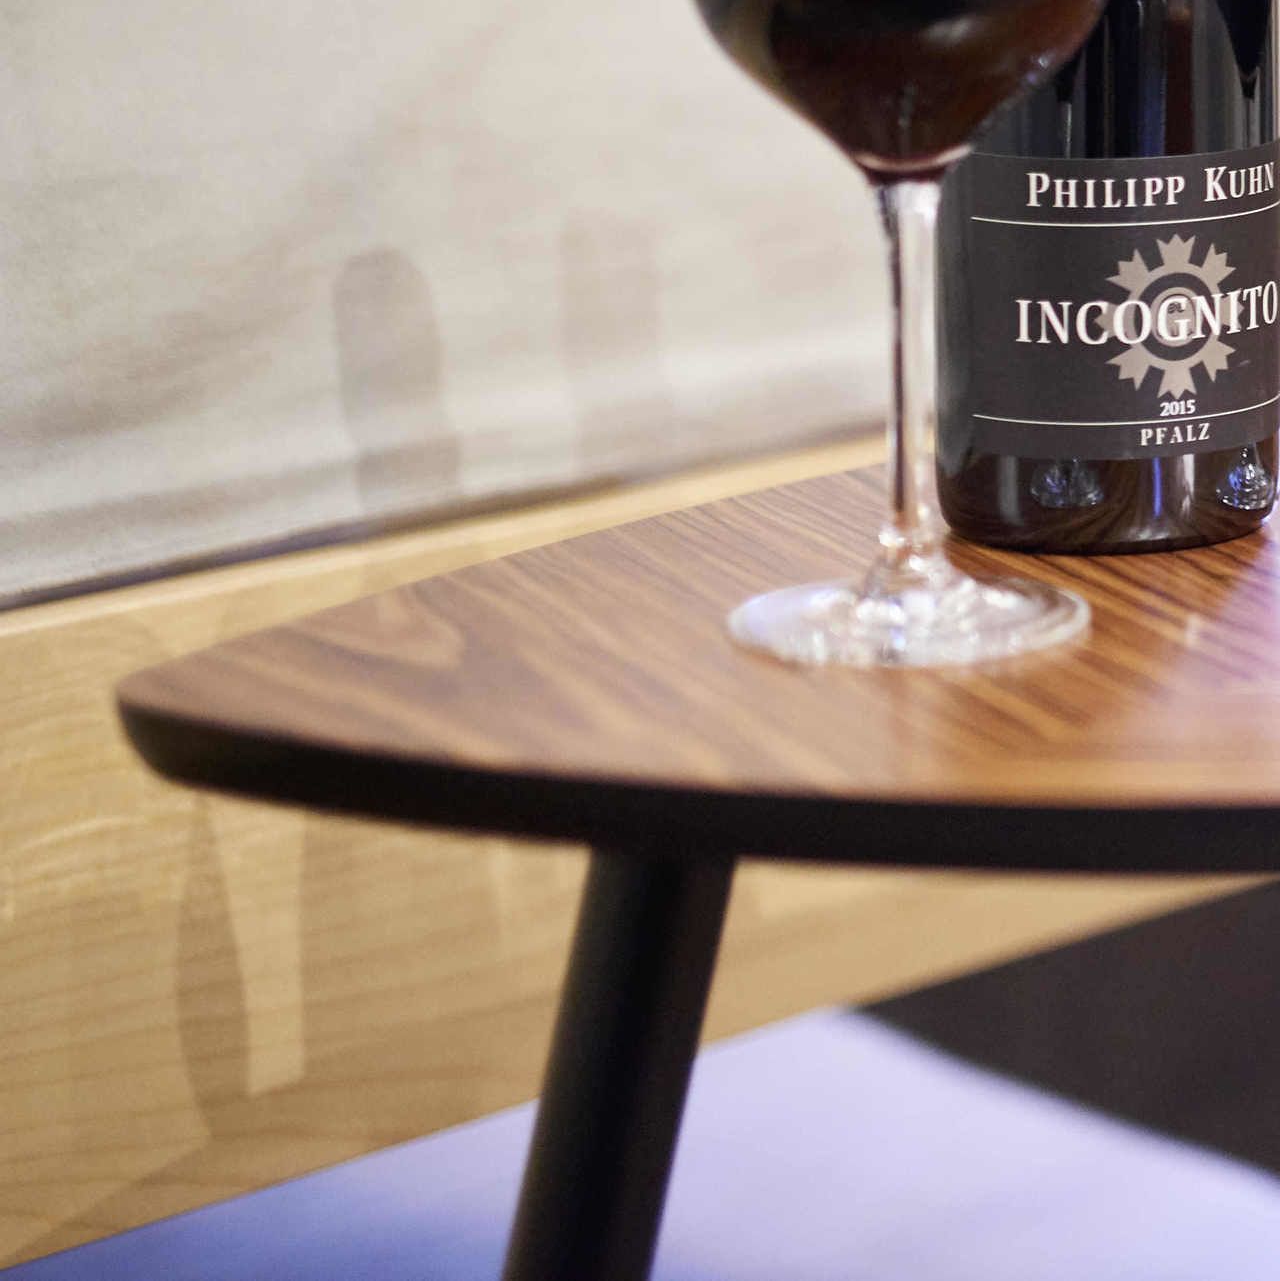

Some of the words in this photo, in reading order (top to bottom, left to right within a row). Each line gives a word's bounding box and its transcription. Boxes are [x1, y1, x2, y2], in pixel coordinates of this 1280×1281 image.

[1026, 172, 1186, 208] PHILIPP
[1204, 162, 1275, 202] KUHN
[1015, 280, 1279, 345] INCOGNITO
[1160, 399, 1197, 417] 2015
[1140, 422, 1211, 446] PFALZ
